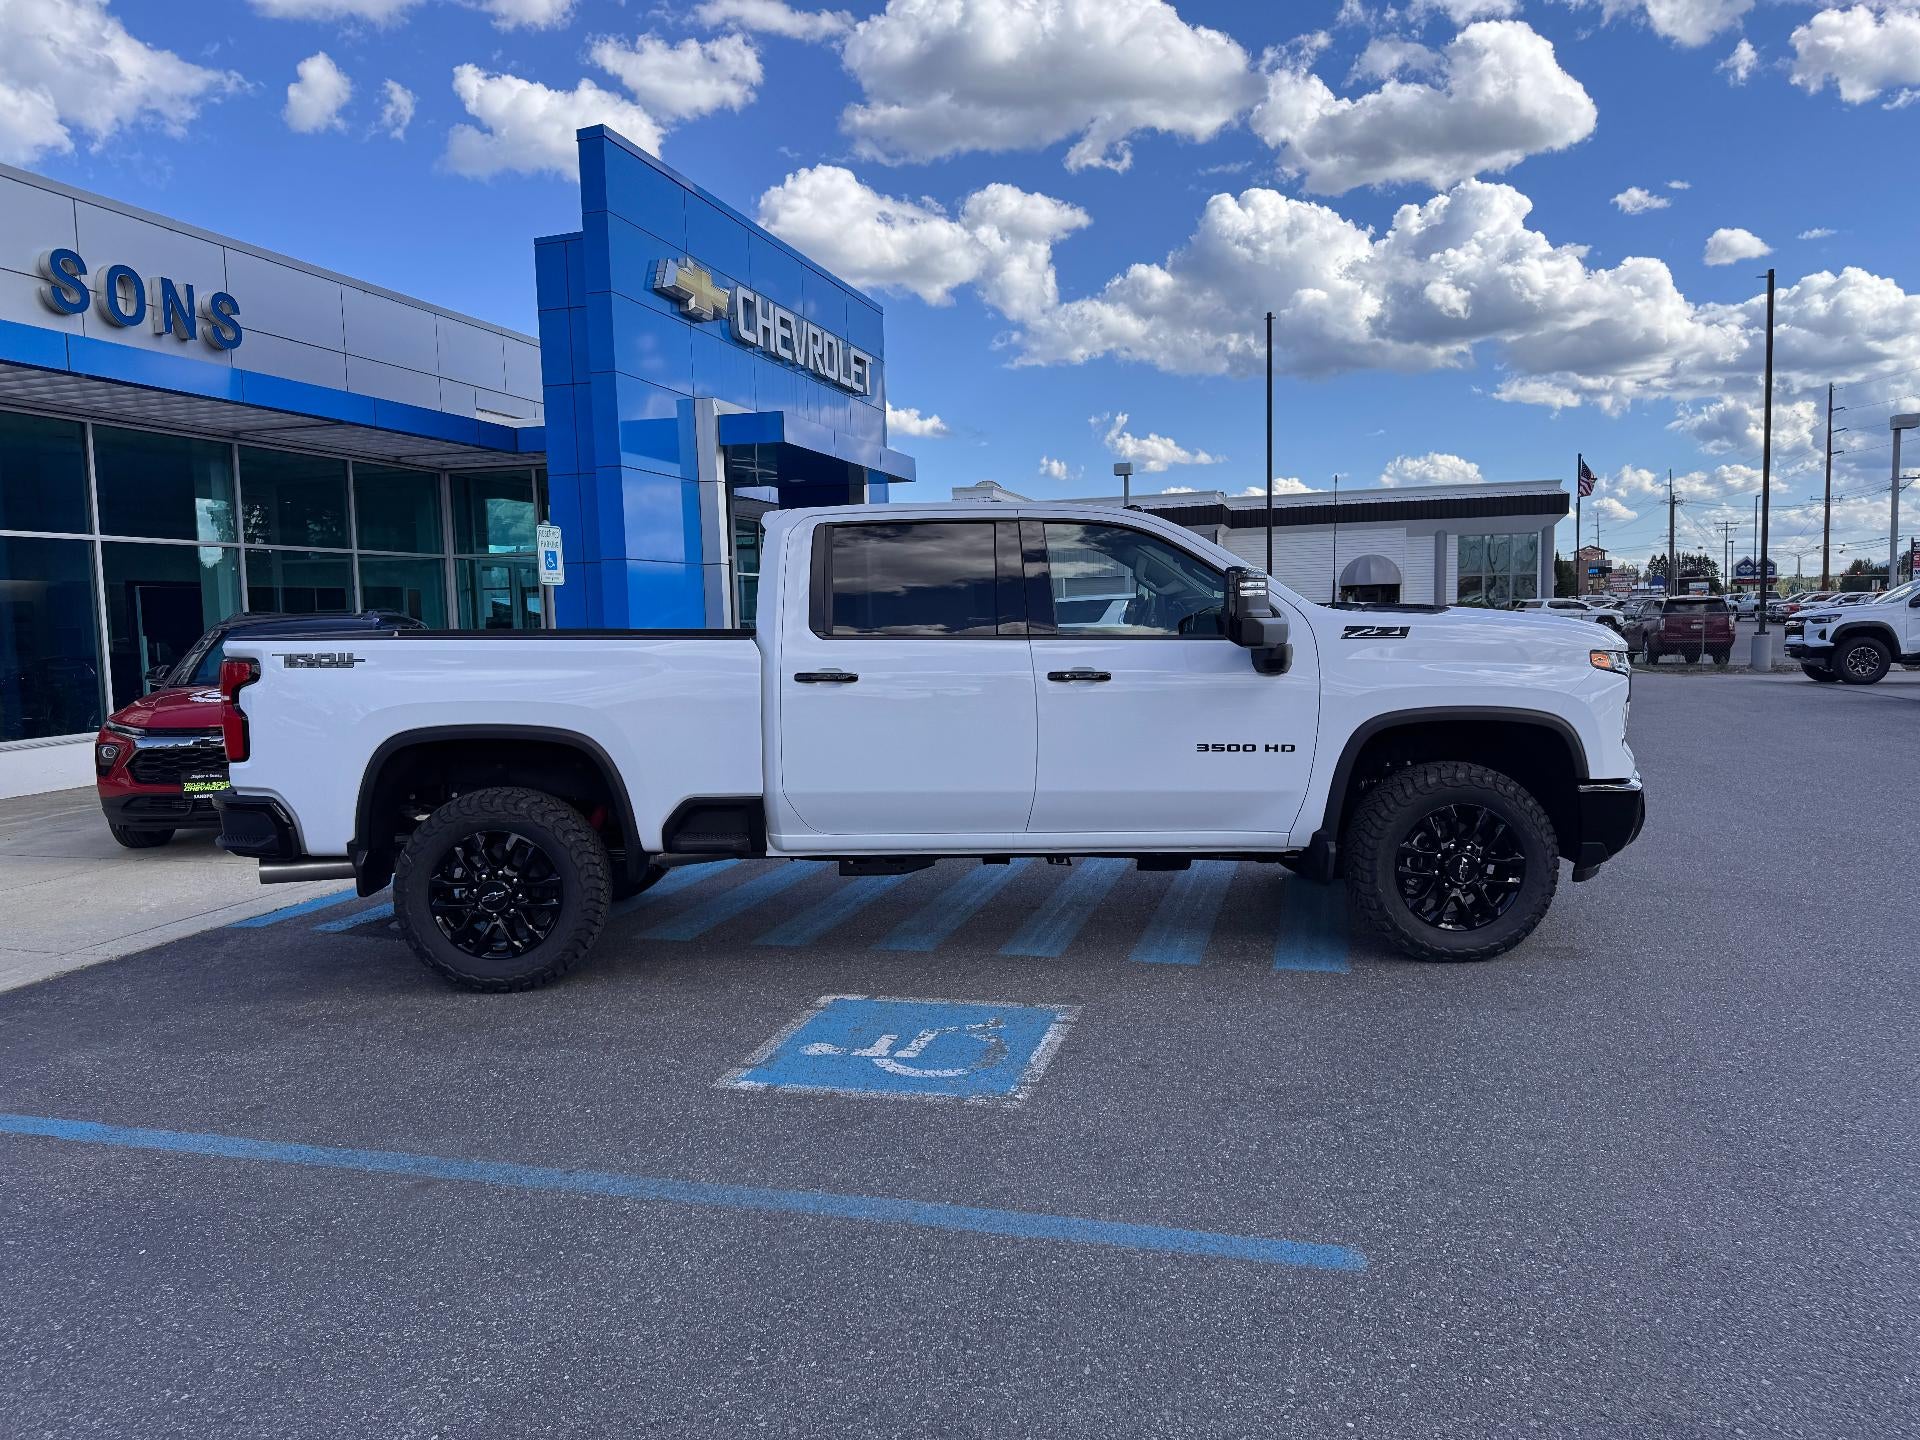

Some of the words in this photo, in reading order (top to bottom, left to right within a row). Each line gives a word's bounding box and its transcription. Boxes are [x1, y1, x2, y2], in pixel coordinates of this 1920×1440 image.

[38, 247, 243, 350] SONS
[733, 286, 873, 395] CHEVROLET
[1341, 626, 1411, 639] Z71
[272, 652, 366, 662] TRAIL
[1196, 743, 1257, 753] 3500
[1264, 743, 1296, 753] HD
